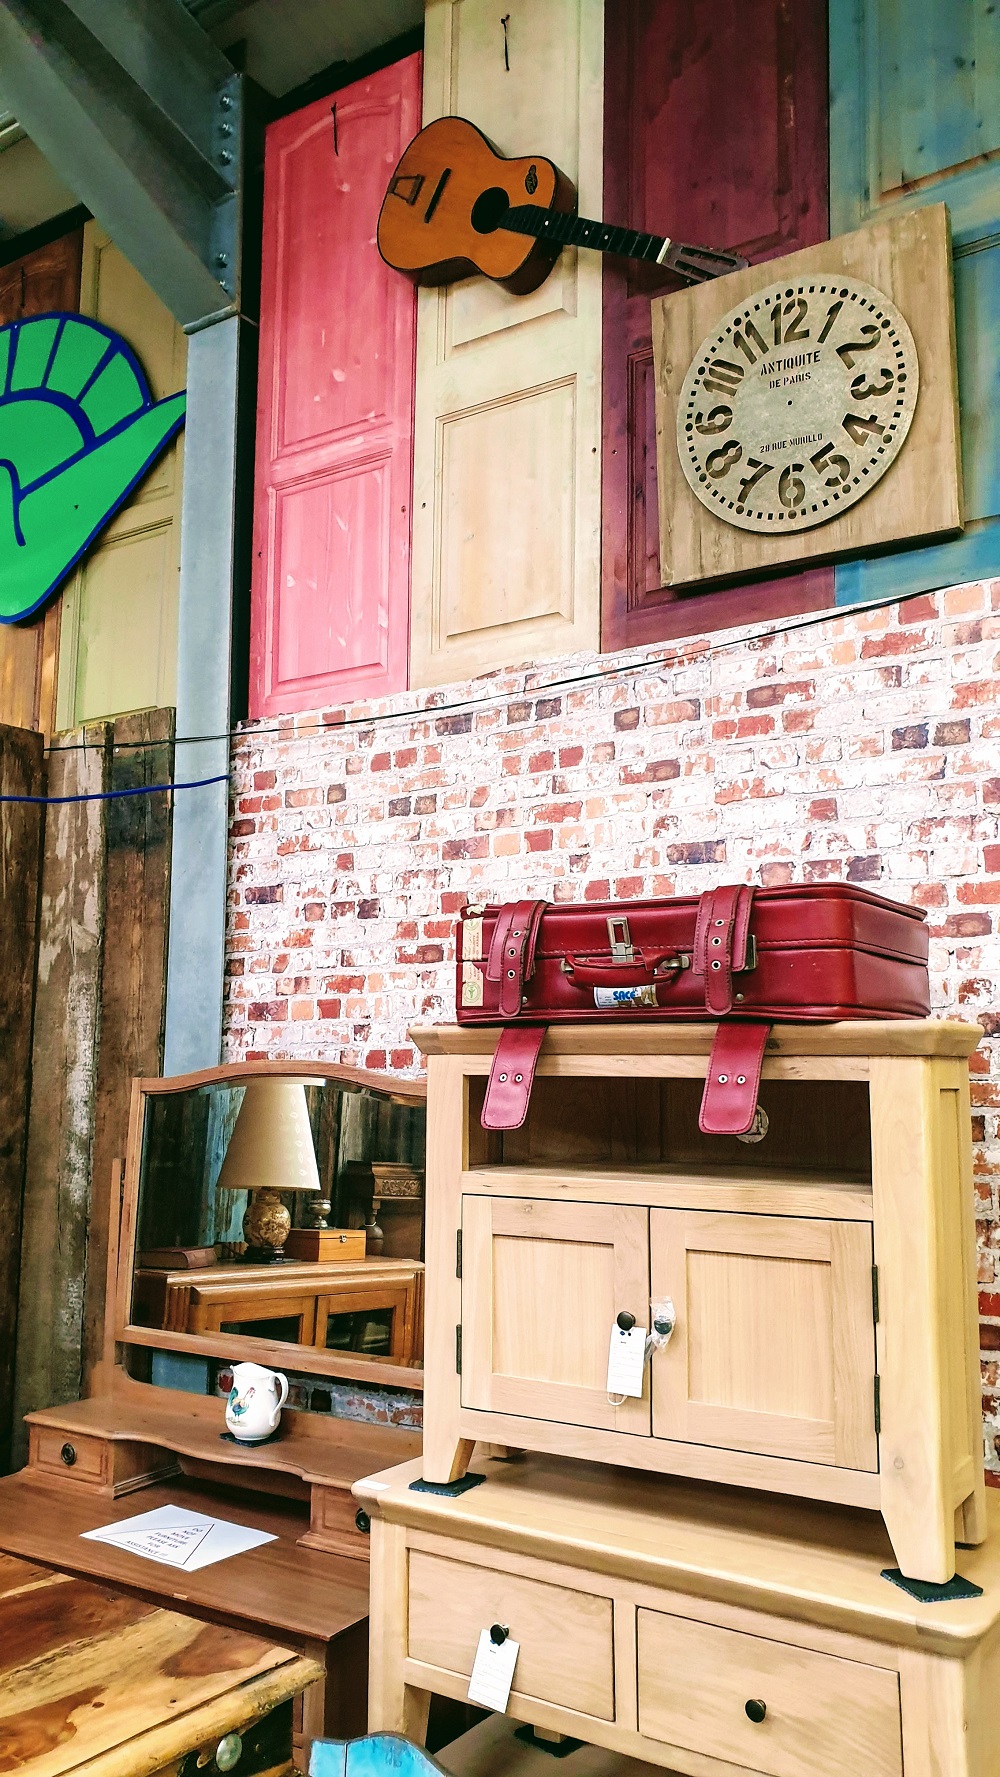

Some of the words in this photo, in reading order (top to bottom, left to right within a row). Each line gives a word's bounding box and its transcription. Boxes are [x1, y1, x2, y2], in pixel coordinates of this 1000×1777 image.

[770, 297, 810, 346] 12
[817, 300, 844, 343] 1
[733, 319, 770, 365] 11
[836, 324, 882, 370] 2
[702, 358, 745, 398] 10
[760, 350, 821, 376] ANTIQUITE
[769, 379, 781, 389] DE
[783, 372, 811, 386] PARIS
[850, 367, 895, 400] 3
[695, 404, 733, 436] 9
[841, 413, 886, 447] 4
[705, 439, 743, 480] 8
[772, 440, 787, 450] RUE
[737, 457, 775, 504] 7
[809, 441, 851, 488] 5
[778, 463, 806, 508] 6
[126, 1540, 160, 1554] ASSISTANCE
[146, 1535, 167, 1544] PLEASE
[155, 1532, 188, 1545] FURNITURE
[171, 1532, 190, 1540] MOVE
